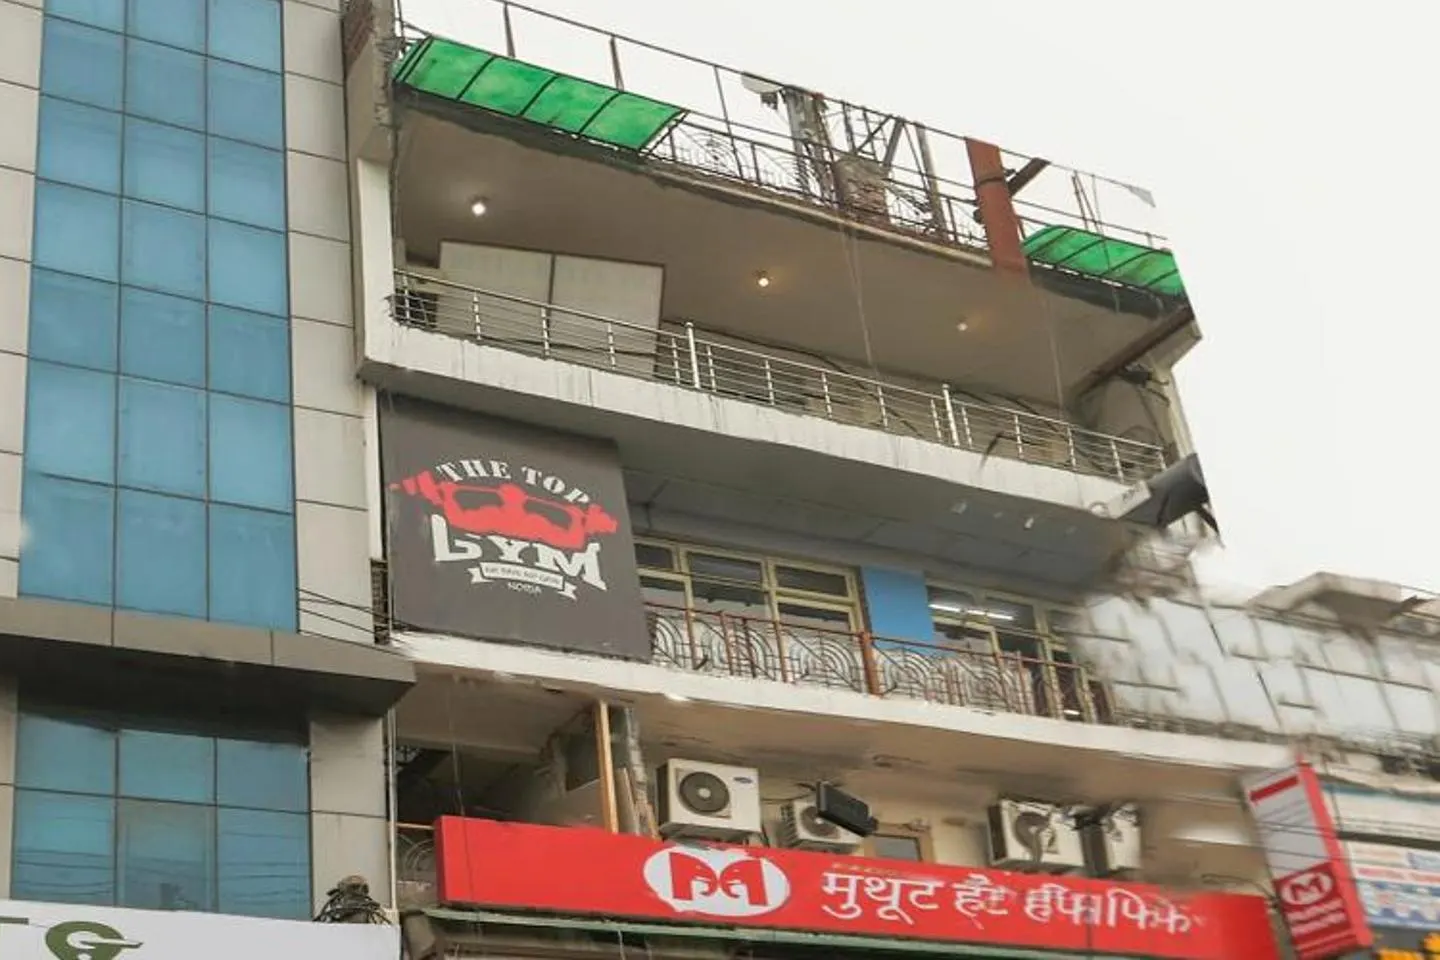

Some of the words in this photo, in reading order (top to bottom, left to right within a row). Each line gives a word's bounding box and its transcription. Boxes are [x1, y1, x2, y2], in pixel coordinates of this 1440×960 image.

[436, 460, 511, 482] THE
[521, 466, 589, 503] TOP
[821, 870, 944, 924] मुथूट
